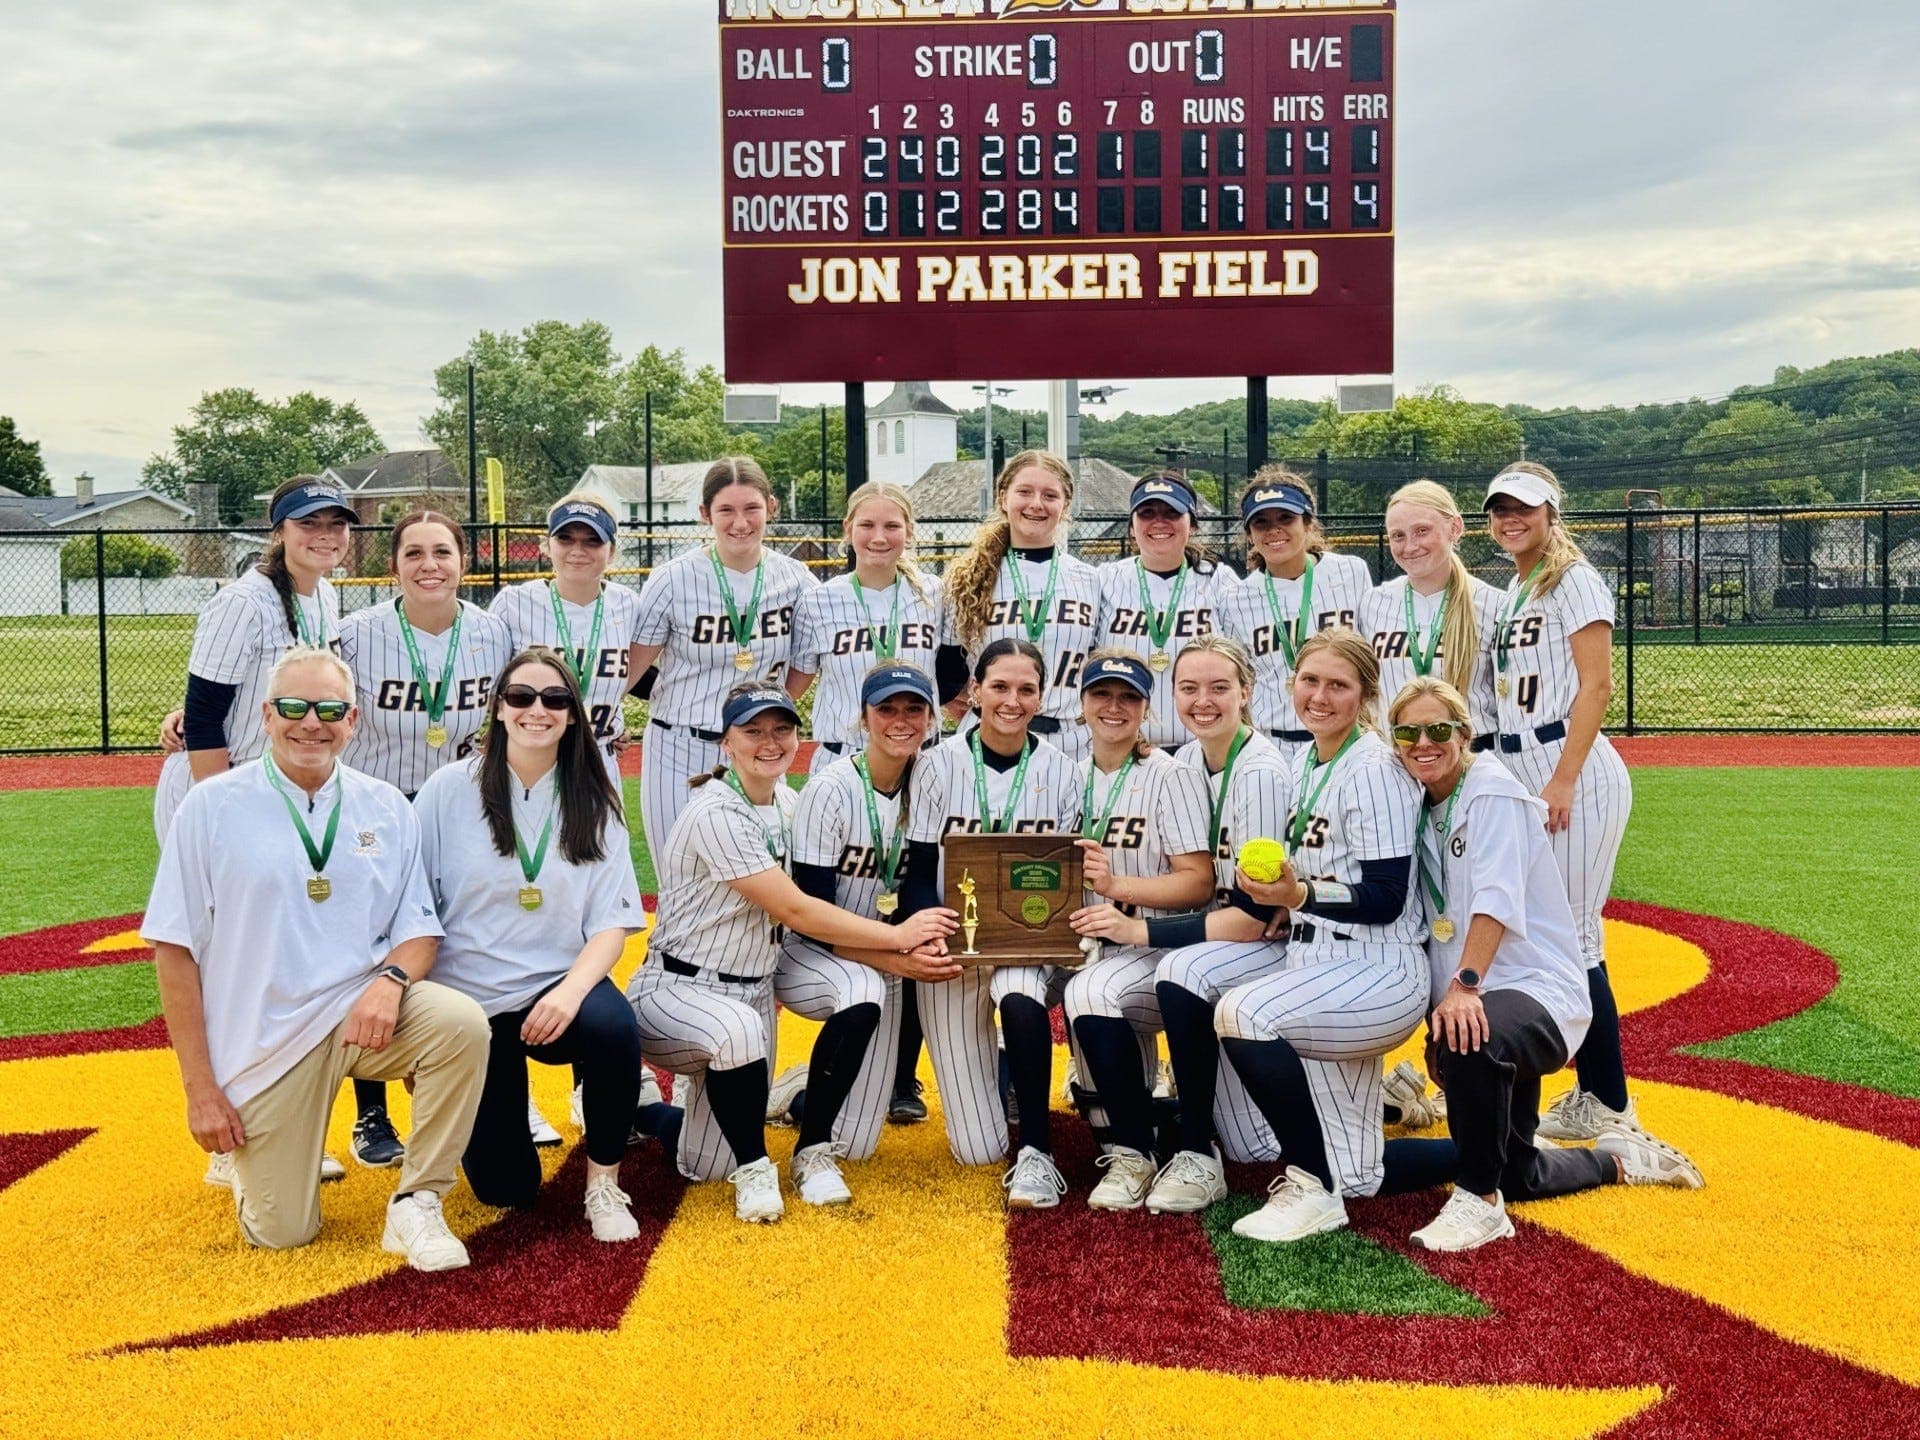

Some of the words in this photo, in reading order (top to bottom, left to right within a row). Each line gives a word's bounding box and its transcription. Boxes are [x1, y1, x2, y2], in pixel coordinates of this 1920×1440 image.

[736, 48, 812, 80] BALL
[822, 38, 850, 88] 0
[914, 44, 1022, 78] STRIKE
[1028, 34, 1056, 85] 0
[1128, 41, 1191, 74] OUT
[1195, 29, 1223, 81] 0
[1290, 37, 1342, 72] H/E
[727, 108, 805, 118] DAKTRONICS
[868, 105, 880, 129] 1
[902, 104, 918, 129] 2
[939, 104, 954, 129] 3
[984, 103, 1000, 127] 4
[1021, 102, 1036, 127] 5
[1057, 101, 1072, 126] 6
[1103, 101, 1118, 125] 7
[1140, 100, 1154, 125] 8
[1183, 97, 1245, 124] RUNS
[1273, 96, 1324, 122] HITS
[1343, 94, 1389, 120] ERR
[732, 140, 846, 179] GUEST
[863, 138, 887, 178] 2
[901, 140, 923, 174] 4
[936, 136, 960, 177] 0
[981, 136, 1004, 176] 2
[1018, 135, 1041, 175] 0
[1054, 134, 1077, 175] 2
[732, 194, 849, 232] ROCKETS
[864, 191, 887, 232] 0
[937, 190, 960, 230] 2
[982, 190, 1005, 230] 2
[1018, 190, 1041, 230] 8
[1055, 191, 1077, 226] 4
[1354, 185, 1377, 220] 4
[788, 256, 901, 304] JON
[917, 252, 1142, 302] PARKER
[1158, 249, 1319, 297] FIELD
[1517, 674, 1539, 713] 4
